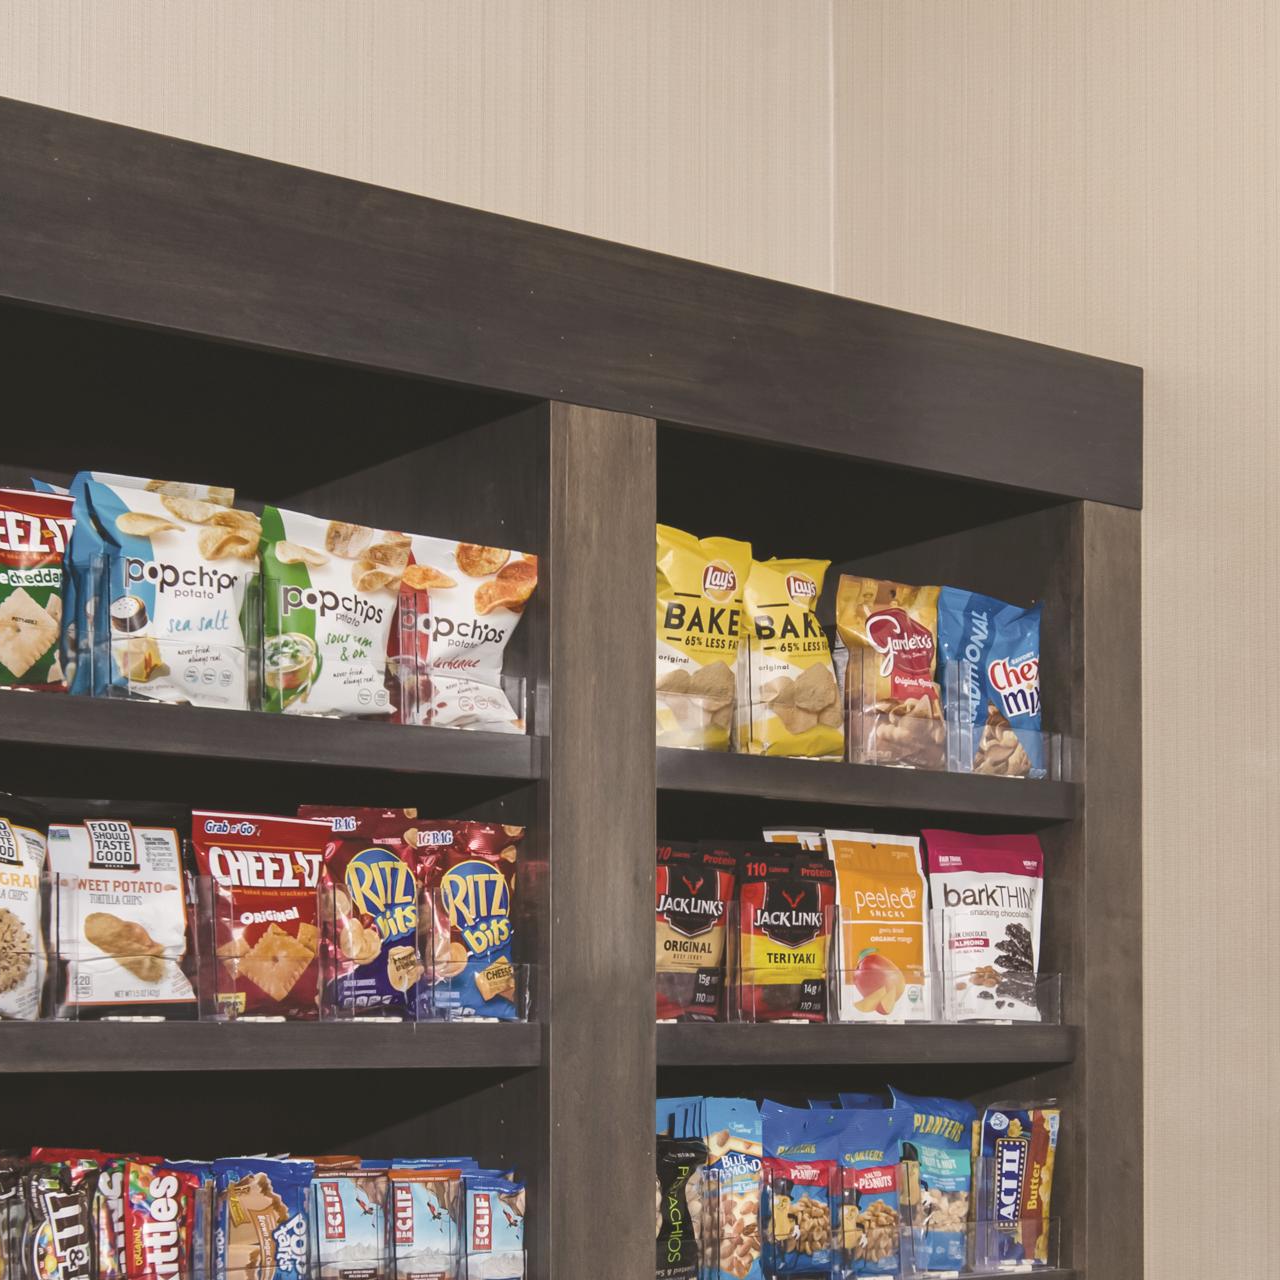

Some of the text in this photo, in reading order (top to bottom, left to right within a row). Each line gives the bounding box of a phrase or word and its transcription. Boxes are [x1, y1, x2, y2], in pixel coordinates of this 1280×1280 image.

[704, 567, 734, 589] Lay's
[174, 589, 214, 599] potato
[788, 575, 816, 598] Lay's
[282, 586, 384, 624] popchips
[168, 609, 228, 632] sea salt
[336, 612, 360, 627] potato
[685, 635, 727, 649] 65% LESS
[658, 654, 690, 664] original
[989, 657, 1039, 691] Chex
[1003, 686, 1040, 717] mix
[90, 822, 127, 833] FOOD
[93, 831, 130, 841] SHOULD
[430, 831, 453, 845] BAG
[95, 841, 131, 850] TASTE
[96, 851, 132, 862] GOOD
[703, 855, 736, 865] Protein
[208, 846, 323, 888] CHEEZ-IT
[746, 863, 767, 876] 110
[800, 868, 832, 877] Protein
[113, 880, 162, 894] POTATO
[347, 861, 407, 914] RITZ
[7, 889, 28, 902] CHIPS
[89, 894, 142, 905] TORTILLA CHIPS
[443, 874, 504, 926] RITZ
[656, 895, 689, 914] JACK
[754, 910, 790, 926] JACK
[870, 910, 905, 918] SNACKS
[374, 906, 417, 941] bits
[465, 919, 510, 954] bits
[664, 940, 712, 953] ORIGINAL
[767, 953, 816, 964] TERIYAKI
[486, 966, 513, 981] CHEESE
[913, 1113, 965, 1142] PLANTERS
[722, 1154, 748, 1169] BLUE
[859, 1176, 892, 1189] PEANUTS
[1027, 1162, 1042, 1211] Butter
[1001, 1175, 1018, 1221] ACT
[394, 1186, 413, 1230] CLIF
[475, 1196, 490, 1235] CLIF
